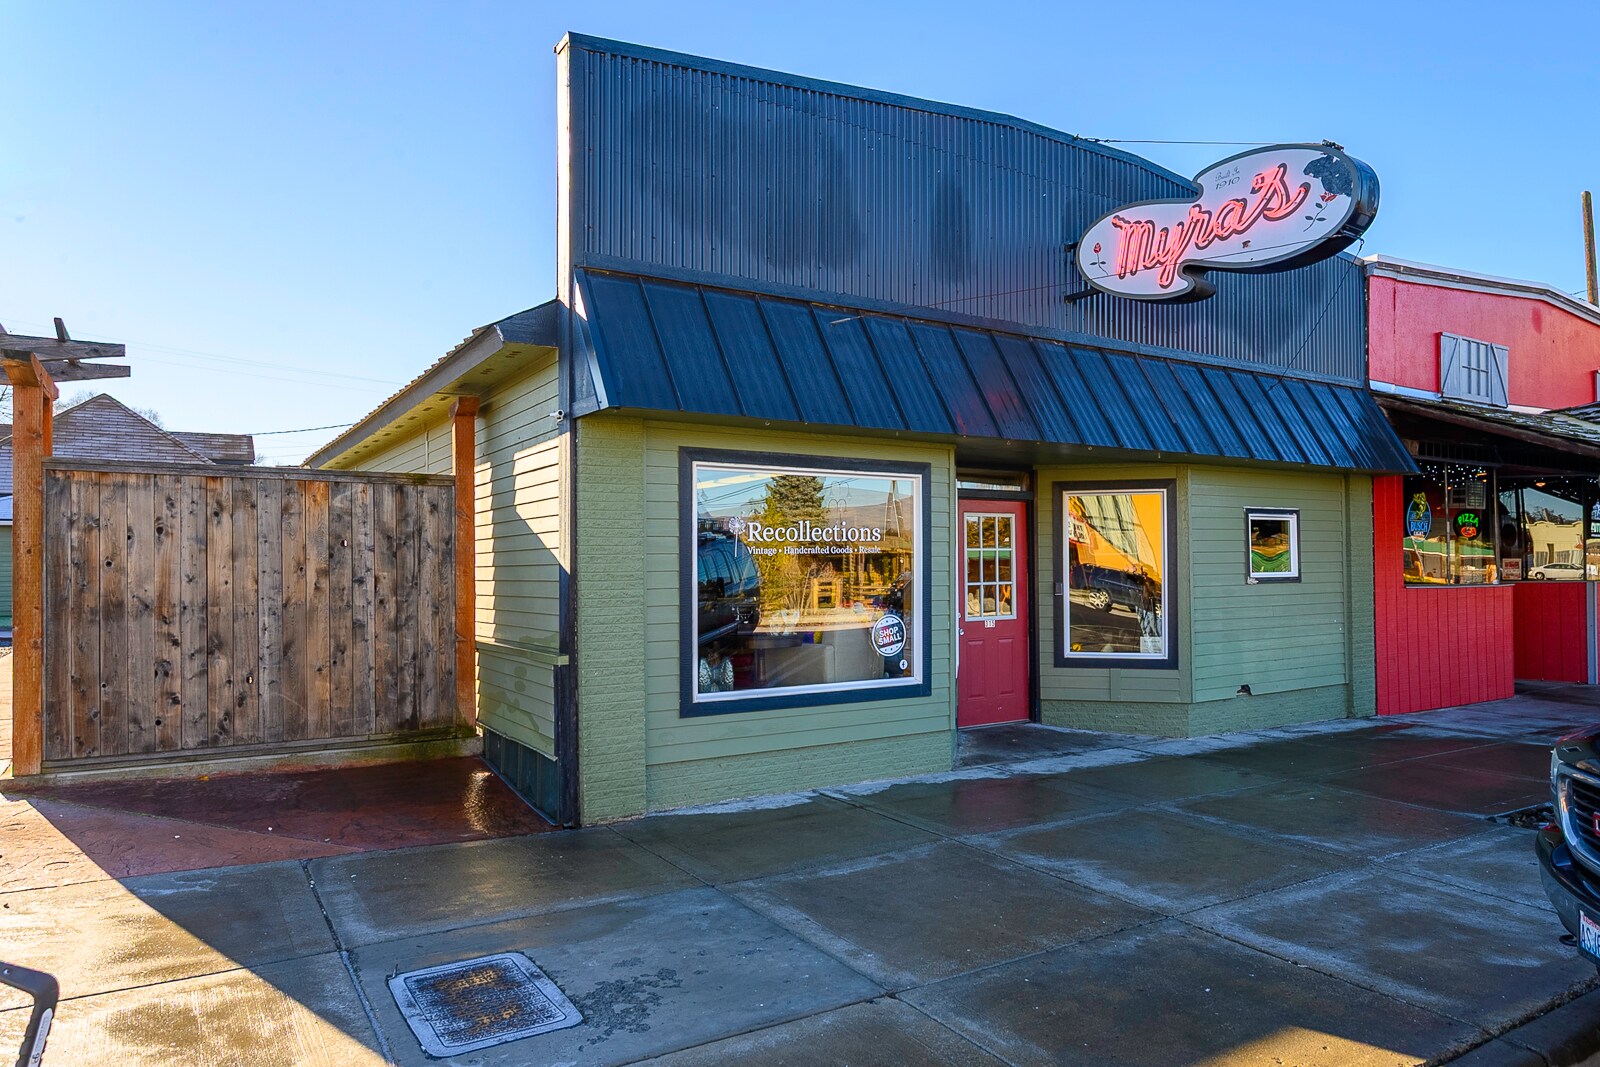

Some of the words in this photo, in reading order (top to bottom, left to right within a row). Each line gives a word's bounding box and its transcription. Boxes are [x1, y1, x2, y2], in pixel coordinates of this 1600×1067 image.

[1215, 176, 1240, 190] 1910
[1111, 162, 1311, 289] Myra's
[1410, 521, 1428, 533] BUSCH
[1457, 513, 1479, 528] PIZZA
[747, 520, 881, 542] Recollections
[747, 546, 777, 557] Vintage
[784, 545, 830, 555] Handcrafted
[831, 546, 853, 555] Goods
[859, 546, 881, 554] Resale
[878, 632, 902, 646] SMALL
[879, 626, 899, 639] SHOP
